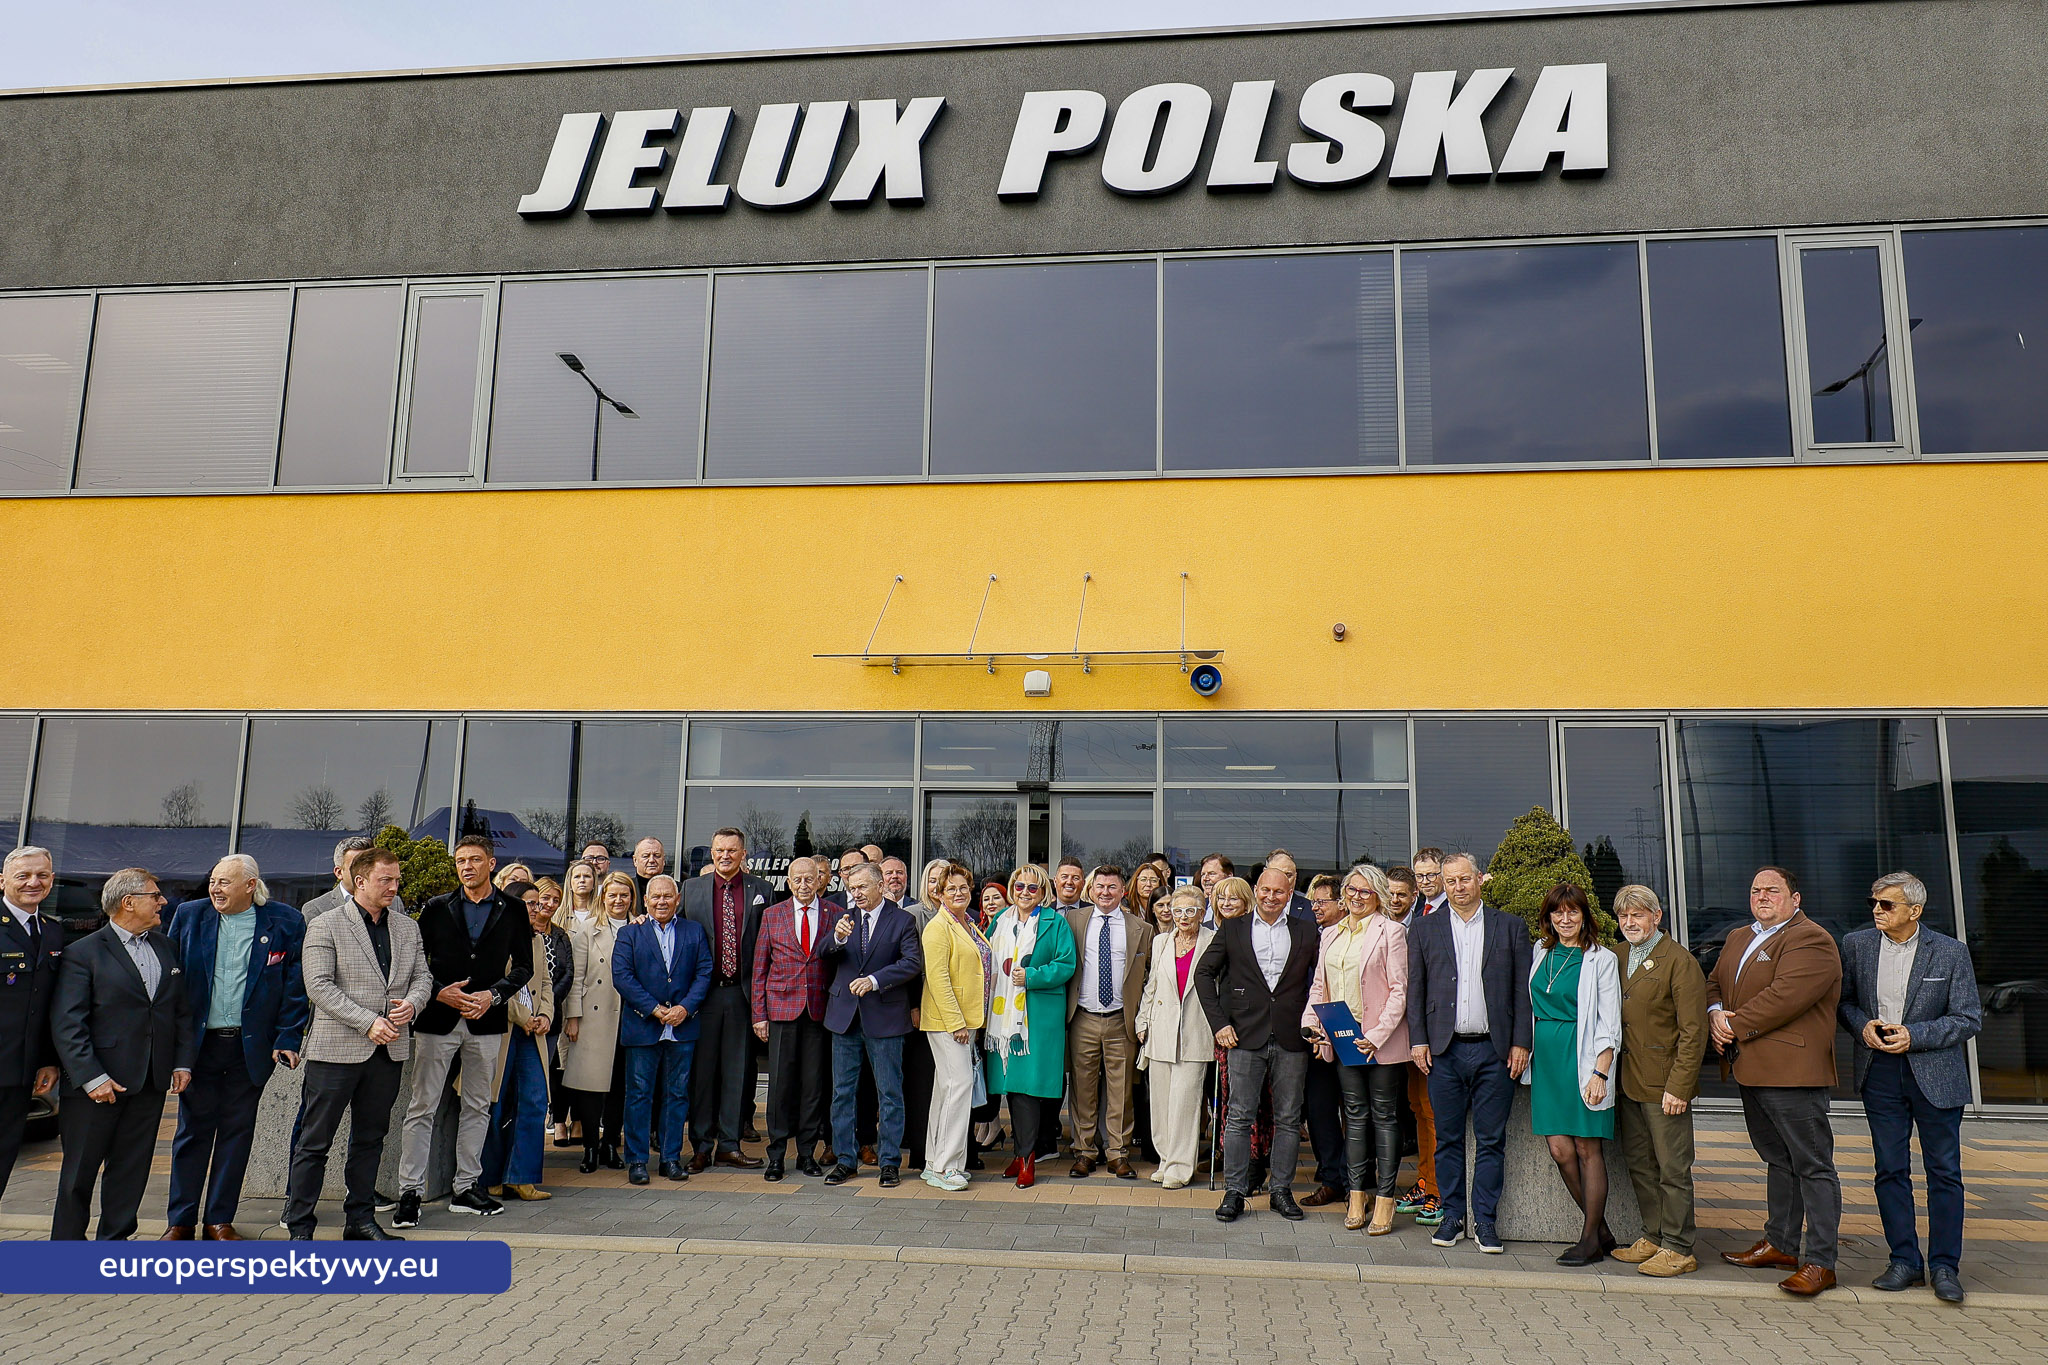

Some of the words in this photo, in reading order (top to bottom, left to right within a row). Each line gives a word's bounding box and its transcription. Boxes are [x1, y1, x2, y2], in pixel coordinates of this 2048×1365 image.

[517, 96, 946, 216] JELUX
[996, 62, 1610, 197] POLSKA
[747, 858, 790, 870] SKLEP
